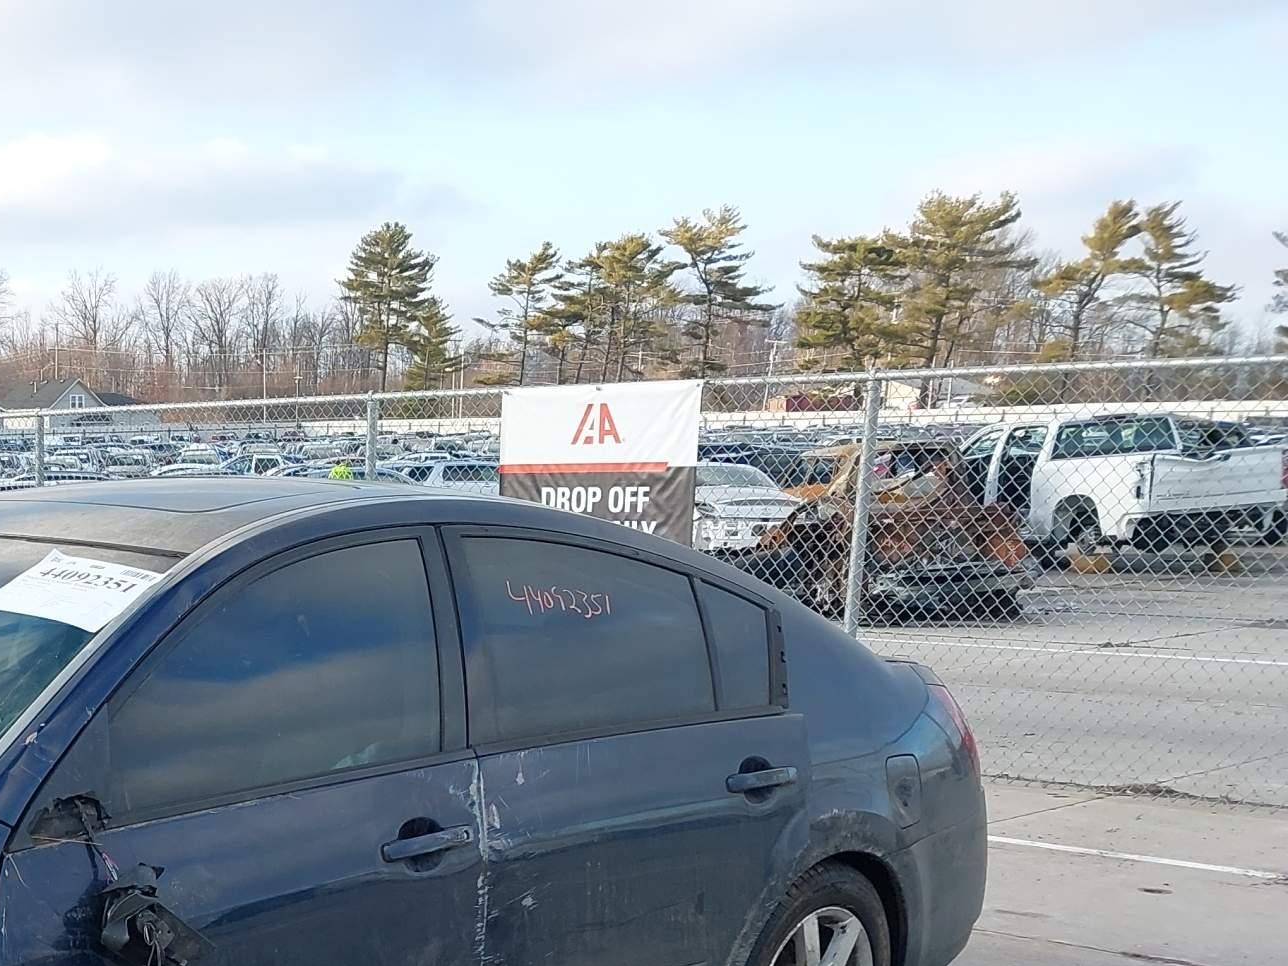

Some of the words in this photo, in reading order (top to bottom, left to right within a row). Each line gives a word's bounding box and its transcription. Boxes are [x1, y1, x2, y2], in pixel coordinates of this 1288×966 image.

[540, 486, 602, 513] DROP
[608, 486, 650, 513] OFF
[40, 567, 138, 592] 44092351
